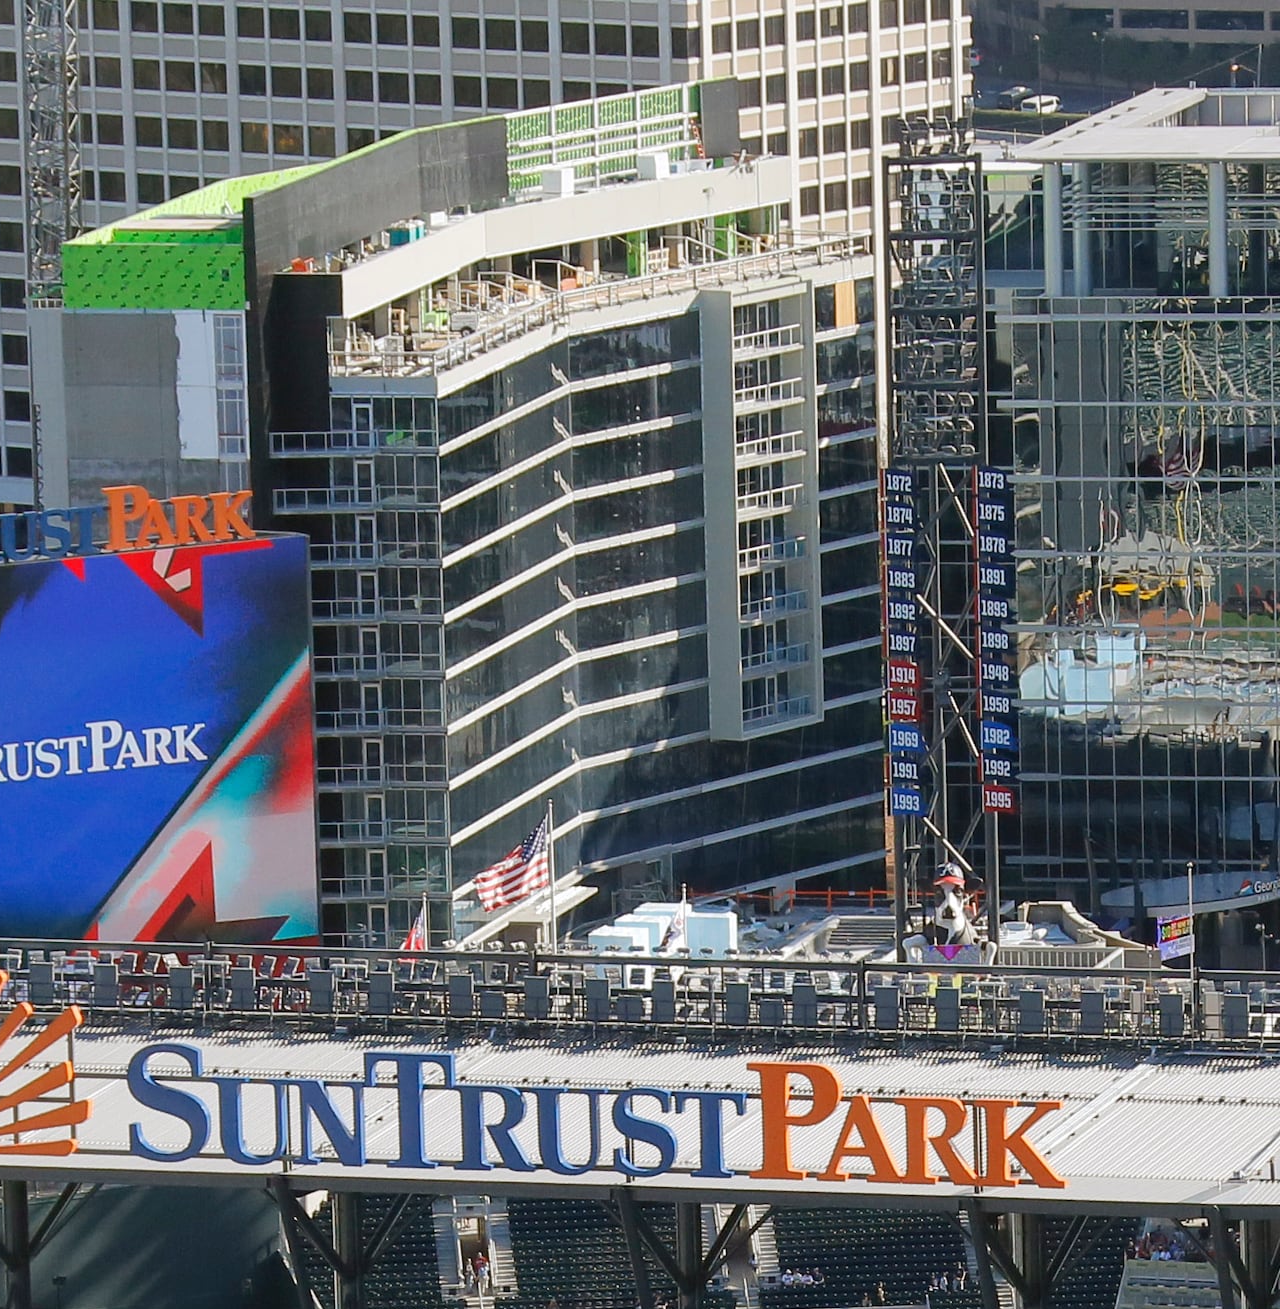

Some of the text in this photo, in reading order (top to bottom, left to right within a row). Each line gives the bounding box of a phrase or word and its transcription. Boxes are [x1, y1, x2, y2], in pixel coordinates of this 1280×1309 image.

[886, 473, 912, 493] 1872
[978, 472, 1005, 489] 1873
[887, 506, 913, 524] 1874
[979, 504, 1005, 521] 1875
[888, 539, 913, 556] 1877
[980, 536, 1006, 553] 1878
[889, 570, 915, 589] 1883
[980, 568, 1006, 585] 1891
[889, 602, 915, 620] 1892
[981, 600, 1007, 617] 1893
[890, 635, 916, 652] 1897
[982, 633, 1008, 649] 1898
[890, 667, 916, 684] 1914
[982, 665, 1009, 681] 1948
[891, 698, 917, 716] 1957
[983, 696, 1009, 713] 1958
[892, 730, 918, 748] 1969
[984, 728, 1010, 745] 1982
[893, 762, 918, 779] 1991
[984, 759, 1011, 776] 1992
[894, 794, 919, 811] 1993
[985, 791, 1012, 808] 1995
